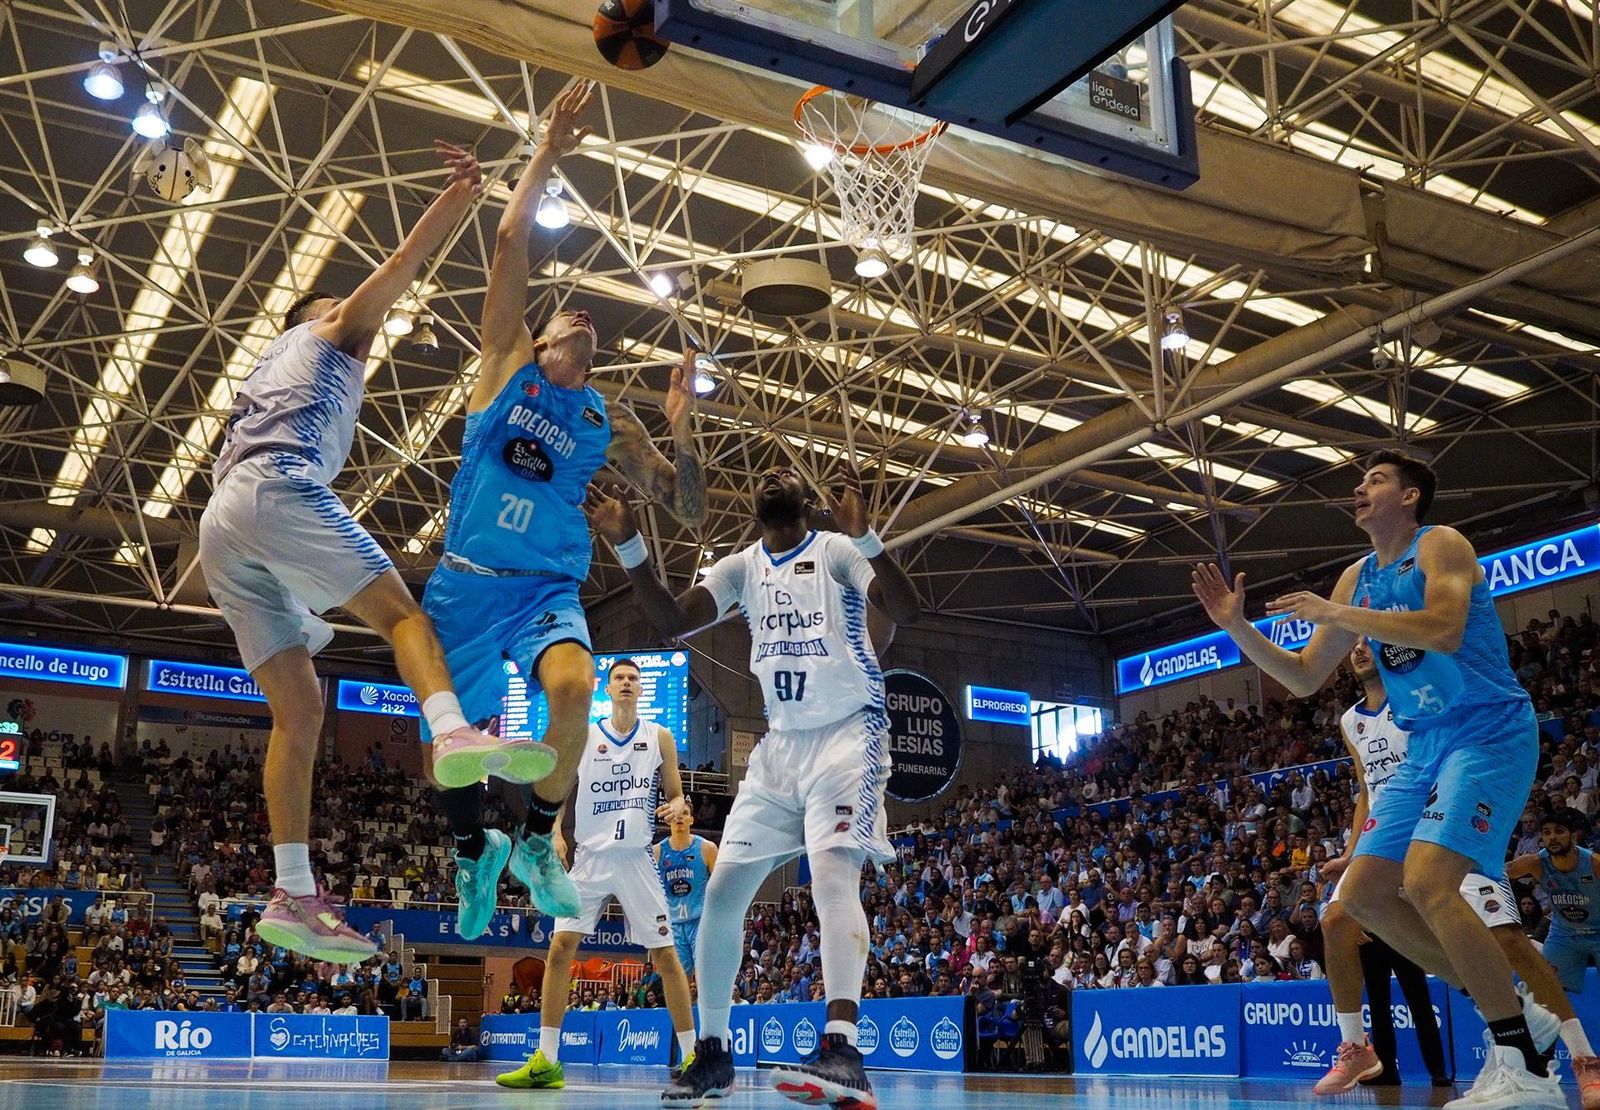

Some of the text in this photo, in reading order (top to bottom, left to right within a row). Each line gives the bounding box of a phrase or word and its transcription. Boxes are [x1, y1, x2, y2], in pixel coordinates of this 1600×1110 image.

[1092, 81, 1113, 97] liga
[1093, 95, 1138, 117] endesa
[497, 493, 535, 534] 20
[1481, 539, 1585, 590] ANCA
[48, 658, 68, 673] de
[73, 662, 109, 681] Lugo
[1155, 646, 1217, 677] CANDELAS
[158, 668, 225, 692] Estrella
[773, 670, 807, 701] 97
[887, 693, 942, 715] GRUPO
[908, 717, 943, 737] LUIS
[889, 735, 943, 756] LESIAS
[898, 763, 947, 777] FUNERARIAS
[591, 776, 650, 796] carplus
[614, 819, 625, 840] 9
[1244, 1003, 1303, 1025] GRUPO
[155, 1020, 212, 1050] Río
[894, 1028, 915, 1038] Estrella
[895, 1038, 915, 1048] Galicia
[935, 1029, 958, 1040] Estrella
[1111, 1025, 1226, 1058] CANDELAS
[936, 1040, 957, 1050] Galicia
